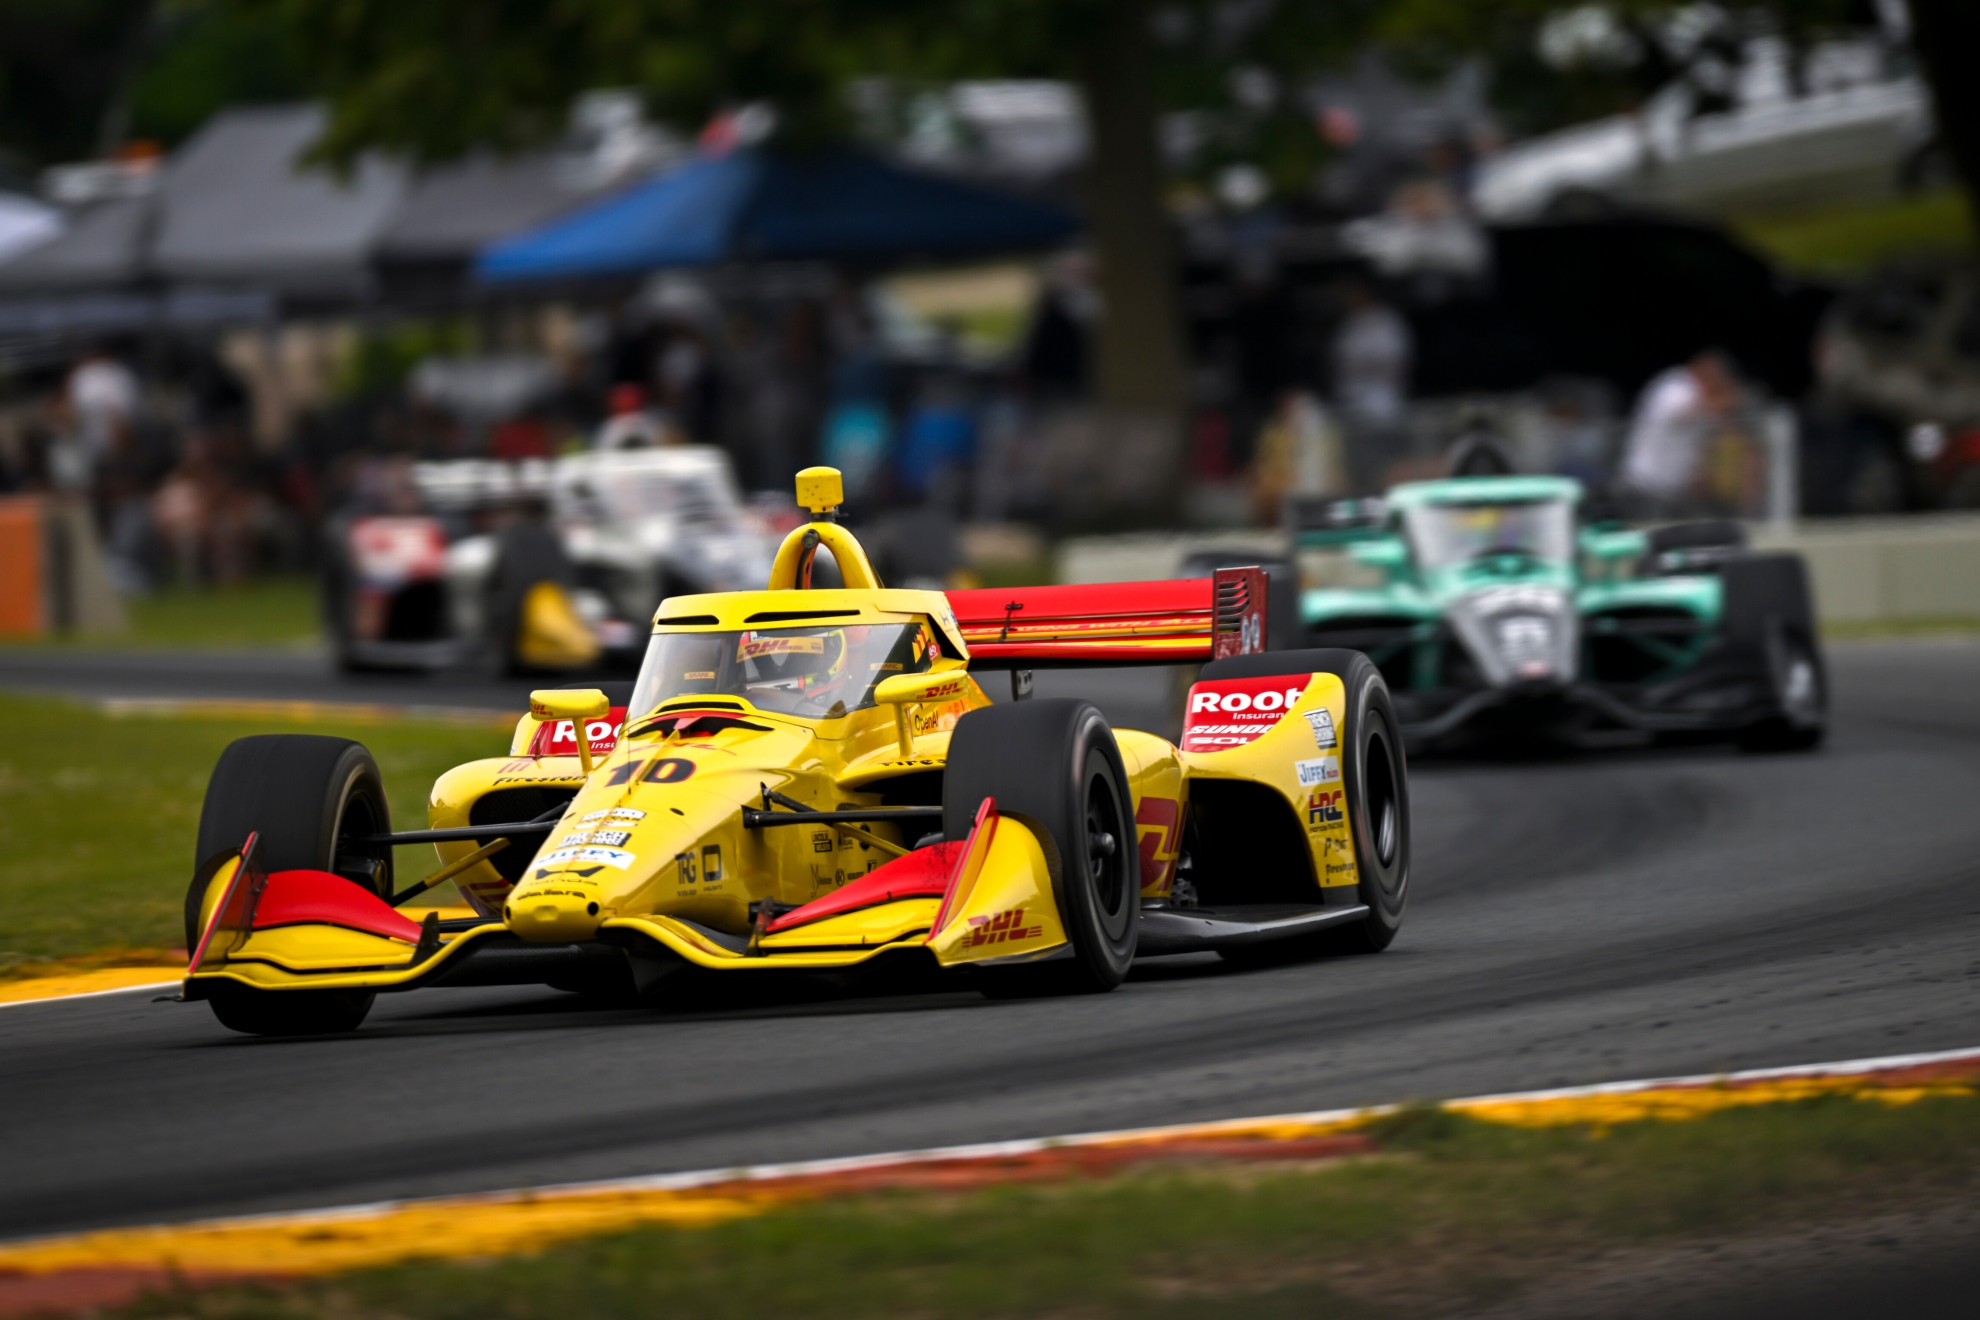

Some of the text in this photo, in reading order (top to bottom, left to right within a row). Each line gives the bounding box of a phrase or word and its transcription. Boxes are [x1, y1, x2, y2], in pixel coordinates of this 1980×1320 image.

[744, 638, 793, 656] DHL
[925, 682, 961, 699] DHL
[914, 710, 939, 734] OpenAI
[603, 757, 697, 788] 10
[1298, 763, 1326, 783] JIFFY
[967, 908, 1029, 947] DHL
